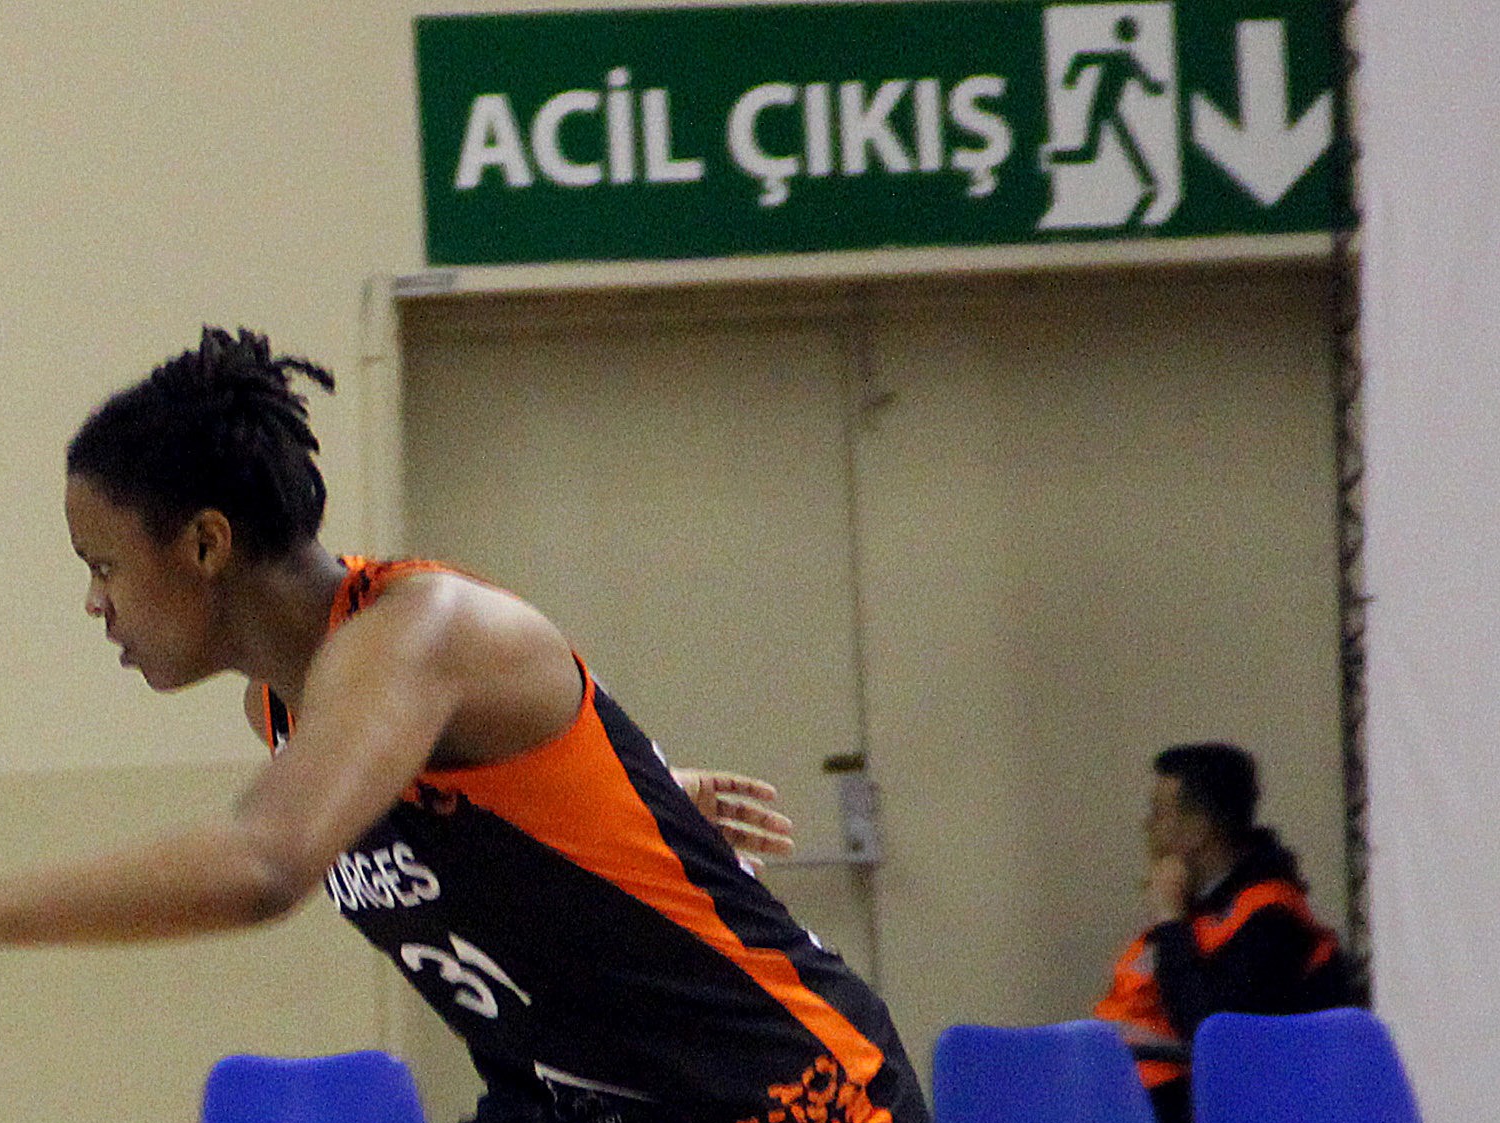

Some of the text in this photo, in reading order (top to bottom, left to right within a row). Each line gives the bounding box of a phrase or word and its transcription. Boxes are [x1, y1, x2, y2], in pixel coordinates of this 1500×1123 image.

[455, 66, 1017, 207] ACİL ÇIKIŞ
[400, 931, 533, 1020] 31
